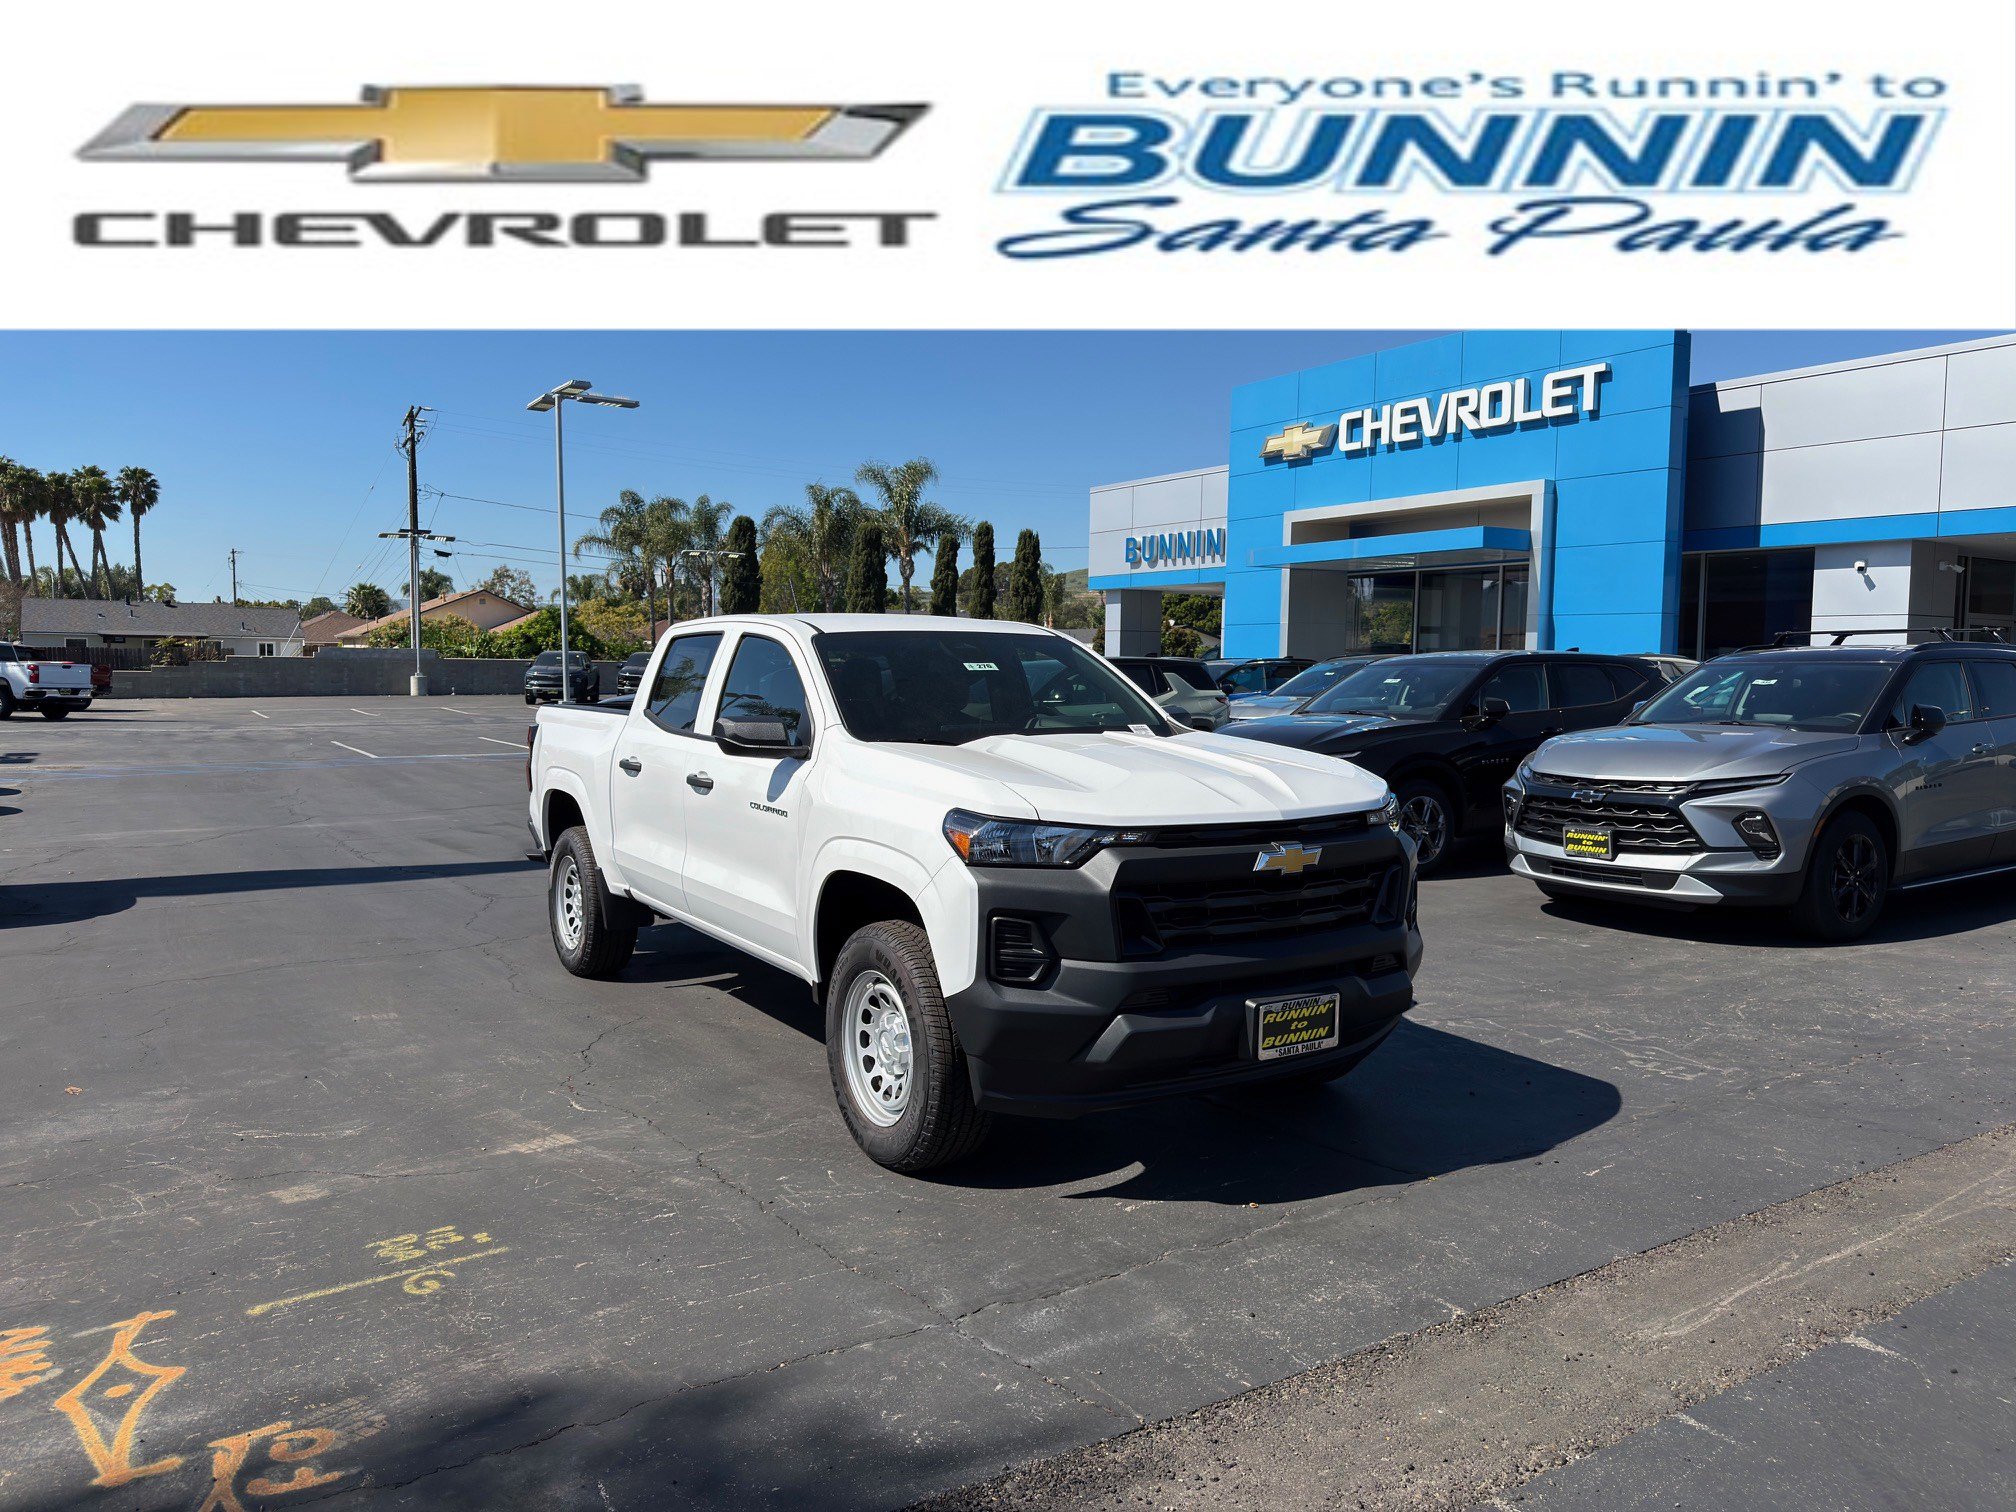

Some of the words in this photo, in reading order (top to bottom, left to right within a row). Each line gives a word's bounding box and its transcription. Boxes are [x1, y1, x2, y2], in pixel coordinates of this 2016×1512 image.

[1337, 363, 1610, 454] CHEVROLET
[1125, 527, 1226, 563] BUNNIN
[749, 801, 789, 818] COLORADO
[1566, 832, 1608, 841] RUNNIN'
[1566, 843, 1607, 854] BUNNIN
[1281, 998, 1320, 1011] BUNNIN
[1263, 1003, 1333, 1024] RUNNIN'
[1291, 1020, 1308, 1029] to
[1262, 1026, 1329, 1049] BUNNIN
